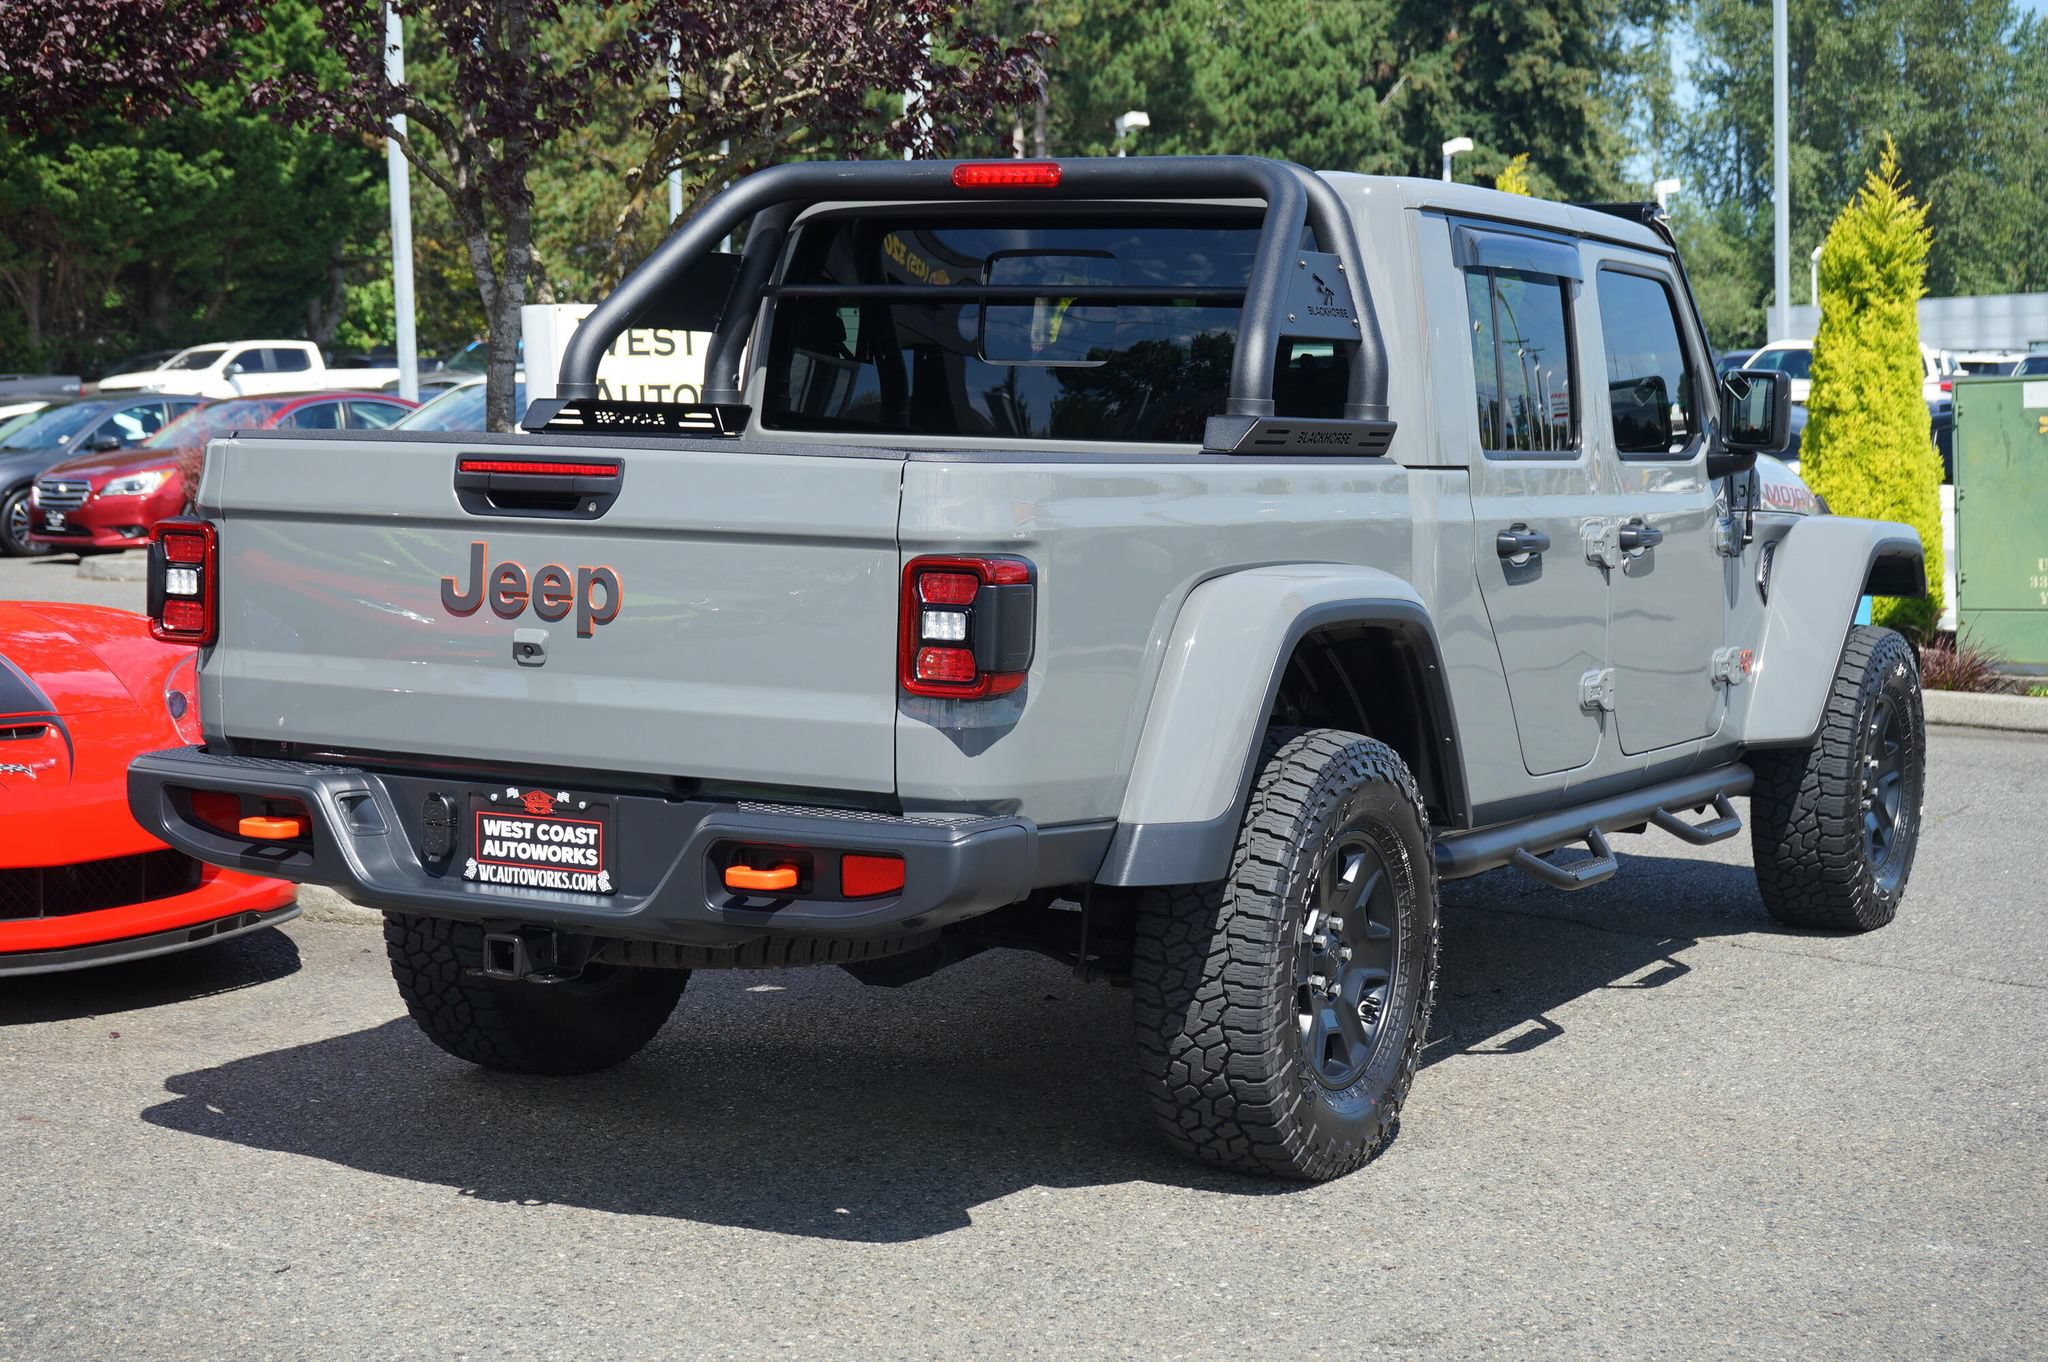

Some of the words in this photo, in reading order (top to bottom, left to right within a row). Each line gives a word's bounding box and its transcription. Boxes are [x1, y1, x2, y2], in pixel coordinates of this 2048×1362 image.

[1307, 304, 1350, 319] BLACKHORSE
[597, 378, 705, 404] AUTO
[1296, 431, 1353, 445] BLACKHORSE
[440, 540, 624, 639] Jeep
[482, 818, 534, 840] WEST
[536, 823, 598, 846] COAST
[482, 839, 599, 867] AUTOWORKS
[477, 863, 598, 892] WCAUTOWORKS.COM
